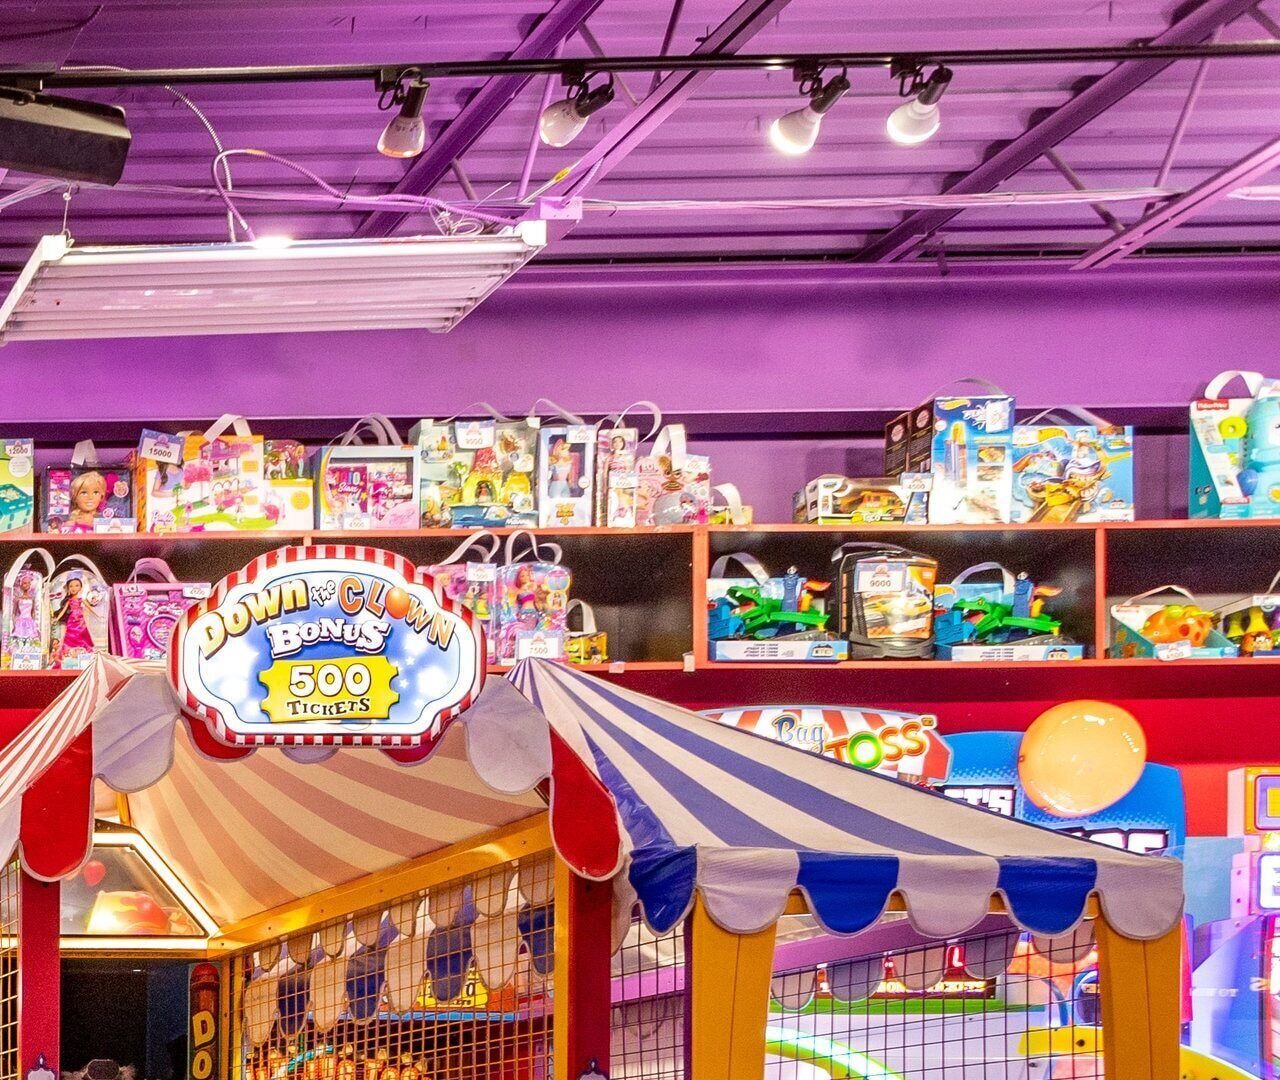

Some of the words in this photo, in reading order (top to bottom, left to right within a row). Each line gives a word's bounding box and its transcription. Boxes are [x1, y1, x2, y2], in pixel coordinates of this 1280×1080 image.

[149, 449, 172, 458] 15000
[869, 580, 891, 588] 9000
[310, 579, 336, 607] the
[338, 575, 458, 651] CLOWN
[266, 617, 392, 660] BONUS
[289, 664, 372, 698] 500
[286, 697, 371, 717] TICKETS
[772, 713, 825, 755] Bag
[824, 721, 928, 770] TOSS
